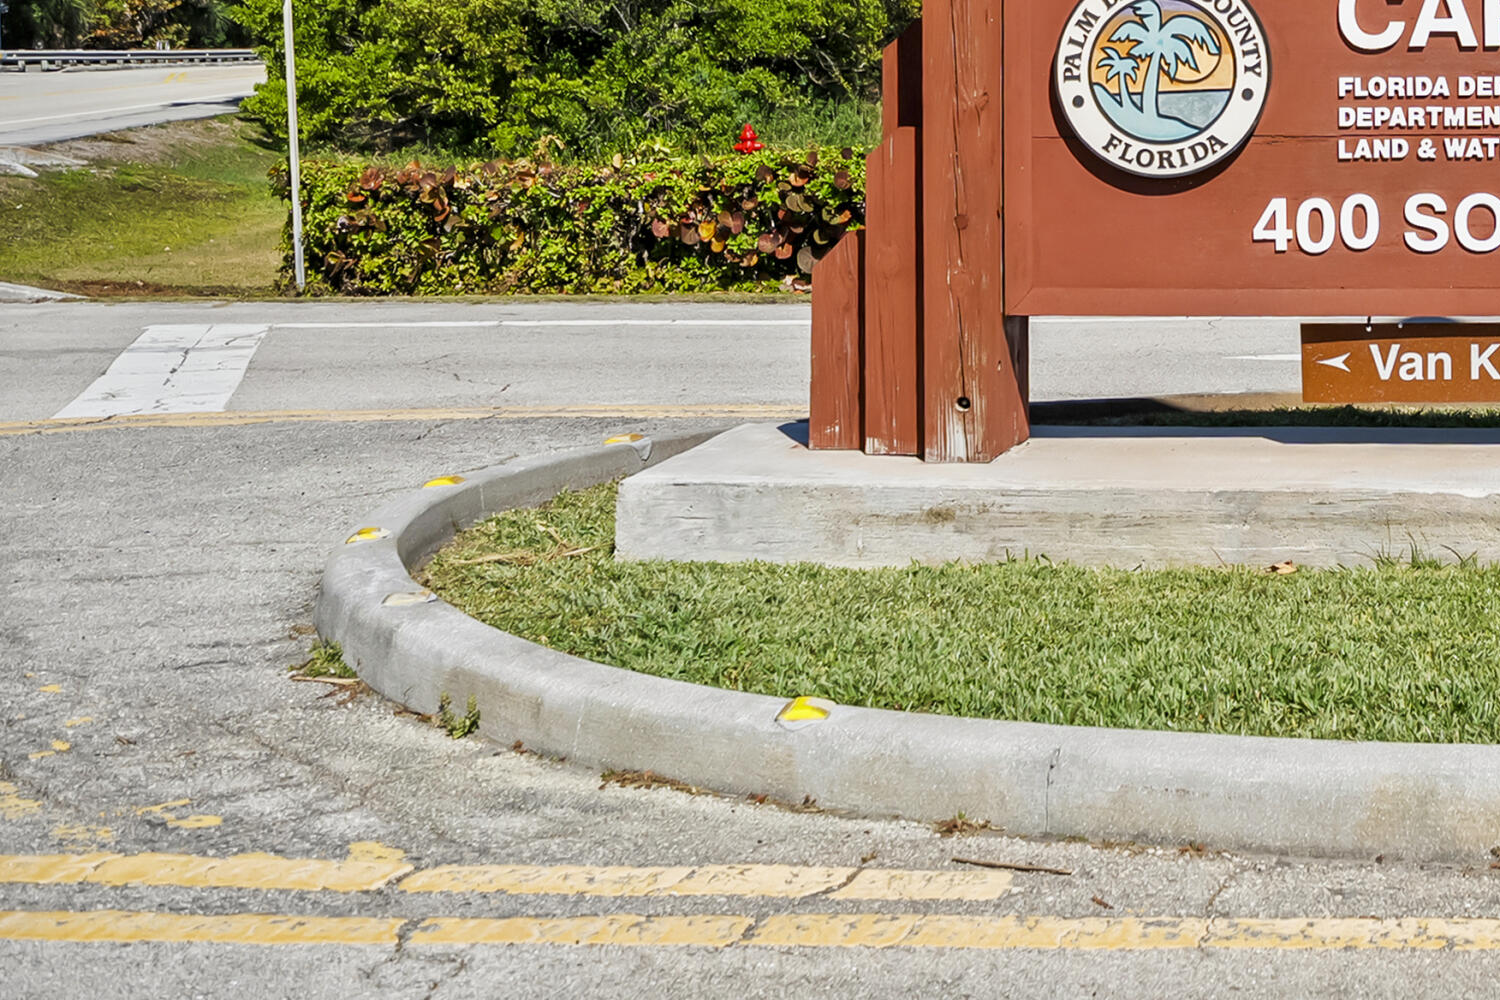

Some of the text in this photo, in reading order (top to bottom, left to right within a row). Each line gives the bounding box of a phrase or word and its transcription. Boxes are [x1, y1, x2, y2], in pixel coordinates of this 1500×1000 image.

[1063, 8, 1100, 84] PALM
[1338, 75, 1451, 97] FLORIDA
[1101, 134, 1228, 169] FLORIDA
[1338, 137, 1410, 159] LAND
[1417, 137, 1437, 159] &
[1252, 192, 1380, 254] 400
[1368, 343, 1452, 381] Van
